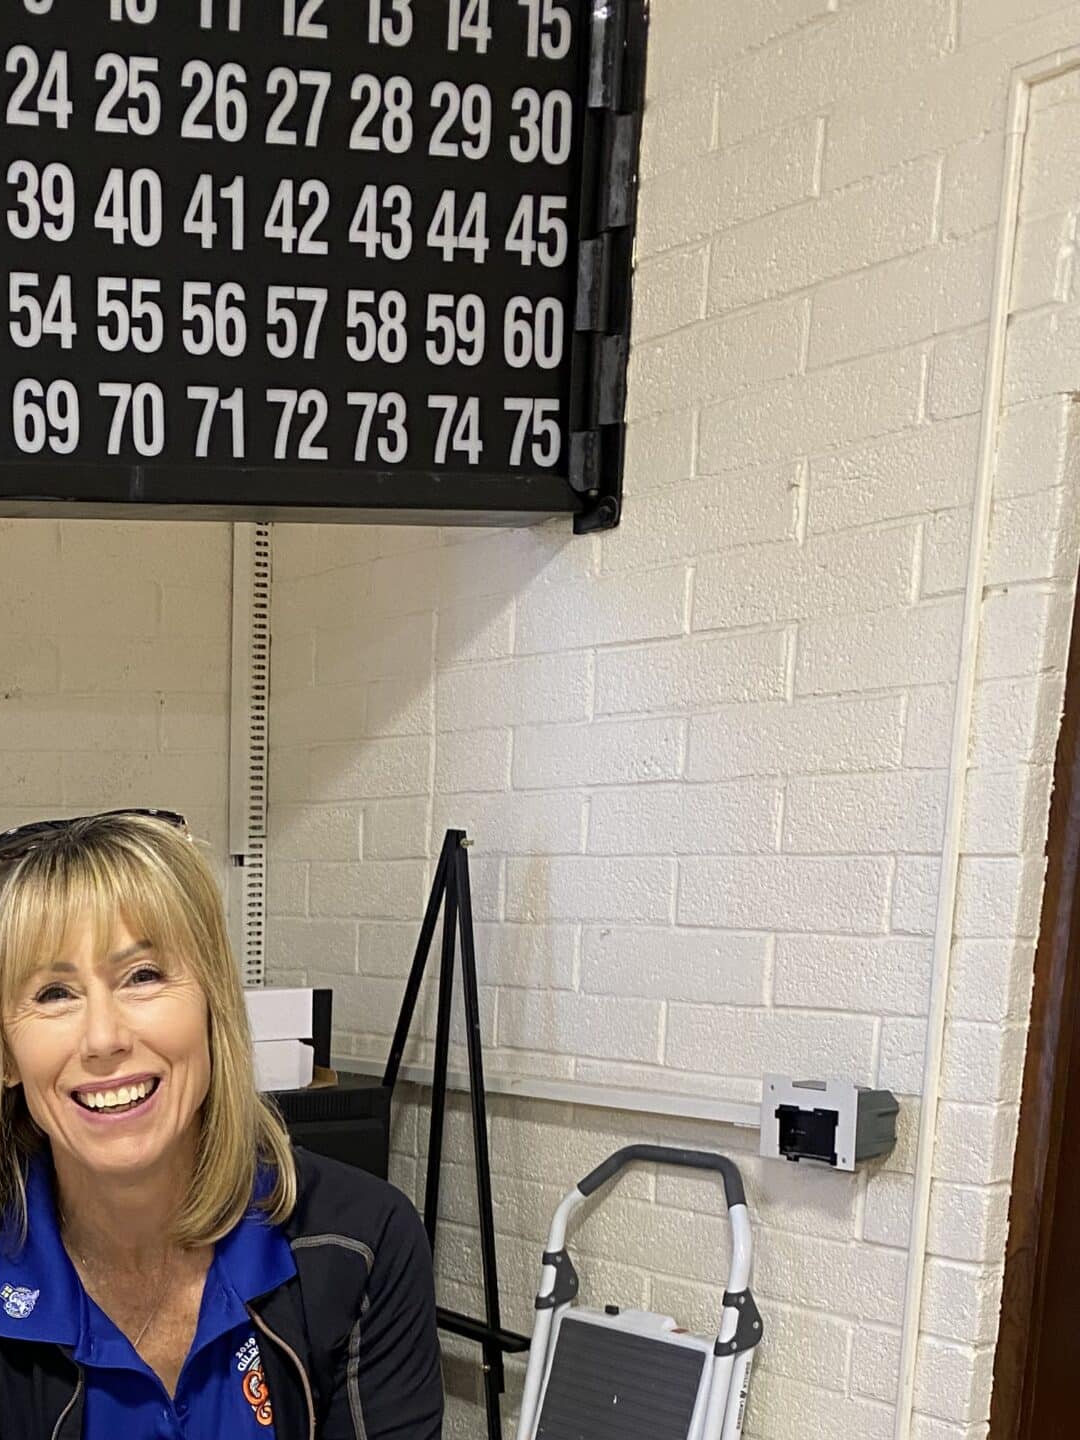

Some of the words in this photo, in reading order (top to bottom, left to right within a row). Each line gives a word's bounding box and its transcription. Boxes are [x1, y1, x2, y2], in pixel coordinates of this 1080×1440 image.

[447, 0, 492, 54] 14
[518, 0, 571, 60] 15
[5, 45, 73, 129] 24
[94, 53, 161, 136] 25
[180, 60, 248, 142] 26
[265, 67, 331, 147] 27
[349, 74, 413, 154] 28
[428, 81, 492, 160] 29
[509, 87, 572, 165] 30
[6, 160, 75, 242] 39
[94, 168, 162, 247] 40
[183, 174, 244, 251] 41
[264, 179, 330, 255] 42
[348, 184, 413, 260] 43
[426, 190, 490, 264] 44
[505, 195, 568, 268] 45
[9, 272, 77, 349] 54
[97, 276, 164, 353] 55
[182, 281, 247, 357] 56
[266, 285, 328, 360] 57
[346, 289, 408, 364] 58
[425, 293, 485, 366] 59
[503, 295, 563, 369] 60
[12, 378, 80, 454] 69
[98, 382, 165, 457] 70
[187, 386, 245, 458] 71
[266, 389, 328, 460] 72
[347, 392, 408, 464] 73
[427, 395, 483, 465] 74
[503, 397, 561, 467] 75
[235, 1337, 256, 1359] 2019
[237, 1345, 260, 1372] GILR
